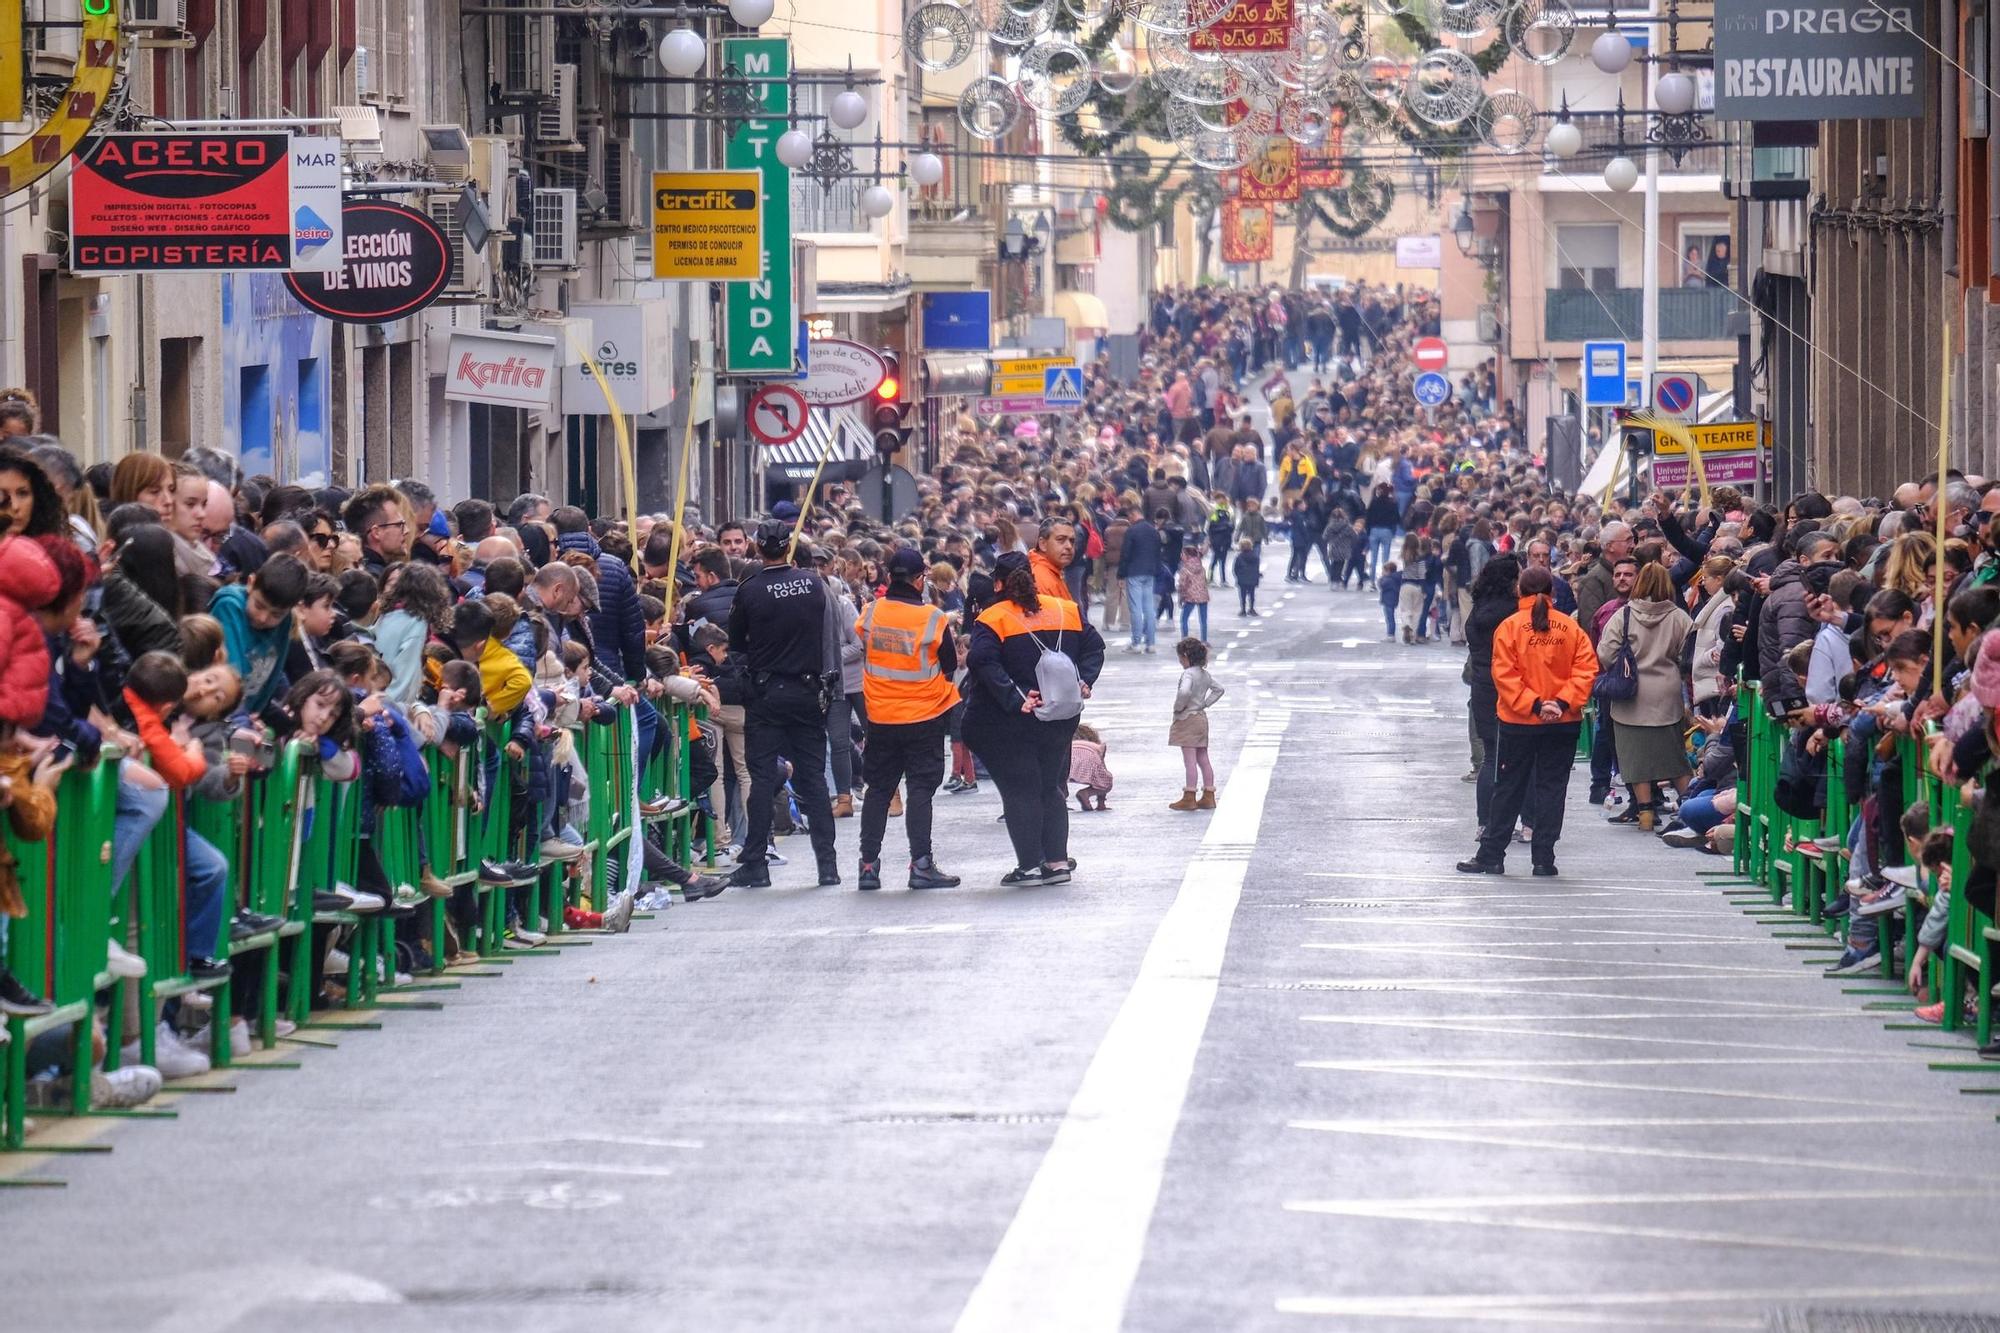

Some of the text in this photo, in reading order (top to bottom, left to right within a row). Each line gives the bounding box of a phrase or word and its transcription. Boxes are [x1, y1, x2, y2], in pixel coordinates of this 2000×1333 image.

[1765, 7, 1914, 34] PRAGA
[1724, 56, 1914, 97] RESTAURANTE
[96, 140, 266, 166] ACERO
[297, 153, 336, 167] MAR
[104, 203, 154, 211] IMPRESIÓN
[156, 203, 192, 211] DIGITAL
[660, 191, 737, 209] trafik
[111, 224, 145, 232] DISEÑO
[147, 224, 167, 232] WEB
[174, 224, 208, 232] DISEÑO
[655, 224, 757, 234] CENTRO MEDICO PSICOTECNICO
[80, 239, 283, 264] COPISTERÍA
[668, 241, 743, 250] PERMISO DE CONDUCIR
[673, 257, 737, 266] LICENCIA DE ARMAS
[323, 261, 413, 291] DE VINOS
[456, 351, 546, 390] katia
[1703, 430, 1755, 445] TEATRE
[1708, 461, 1753, 471] Universidad
[774, 586, 811, 599] LOCAL
[1528, 635, 1566, 648] Epsilon
